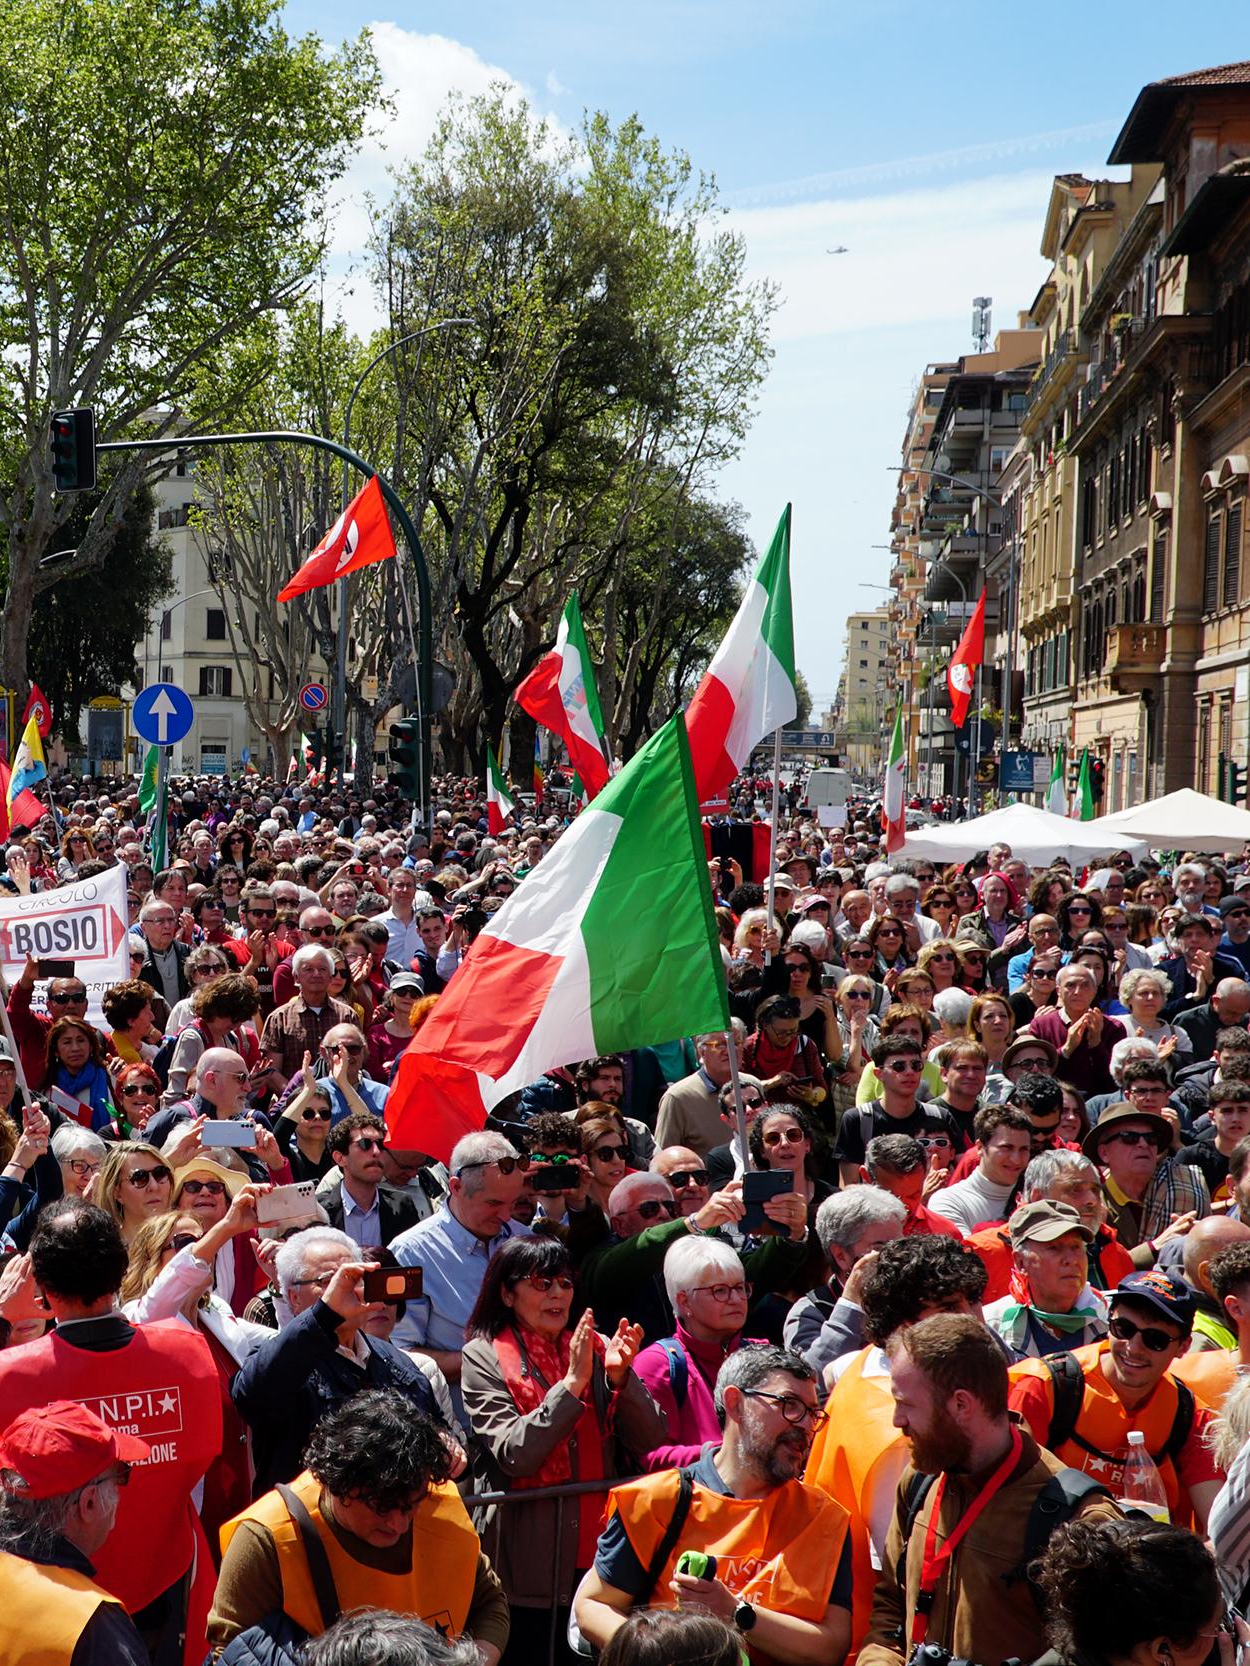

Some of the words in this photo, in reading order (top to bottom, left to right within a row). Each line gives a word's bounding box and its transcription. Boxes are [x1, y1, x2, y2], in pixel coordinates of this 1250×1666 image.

[18, 882, 98, 912] CIRCOLO
[15, 915, 98, 955] BOSIO
[98, 1393, 159, 1423] N.P.I.
[108, 1423, 140, 1437] oma
